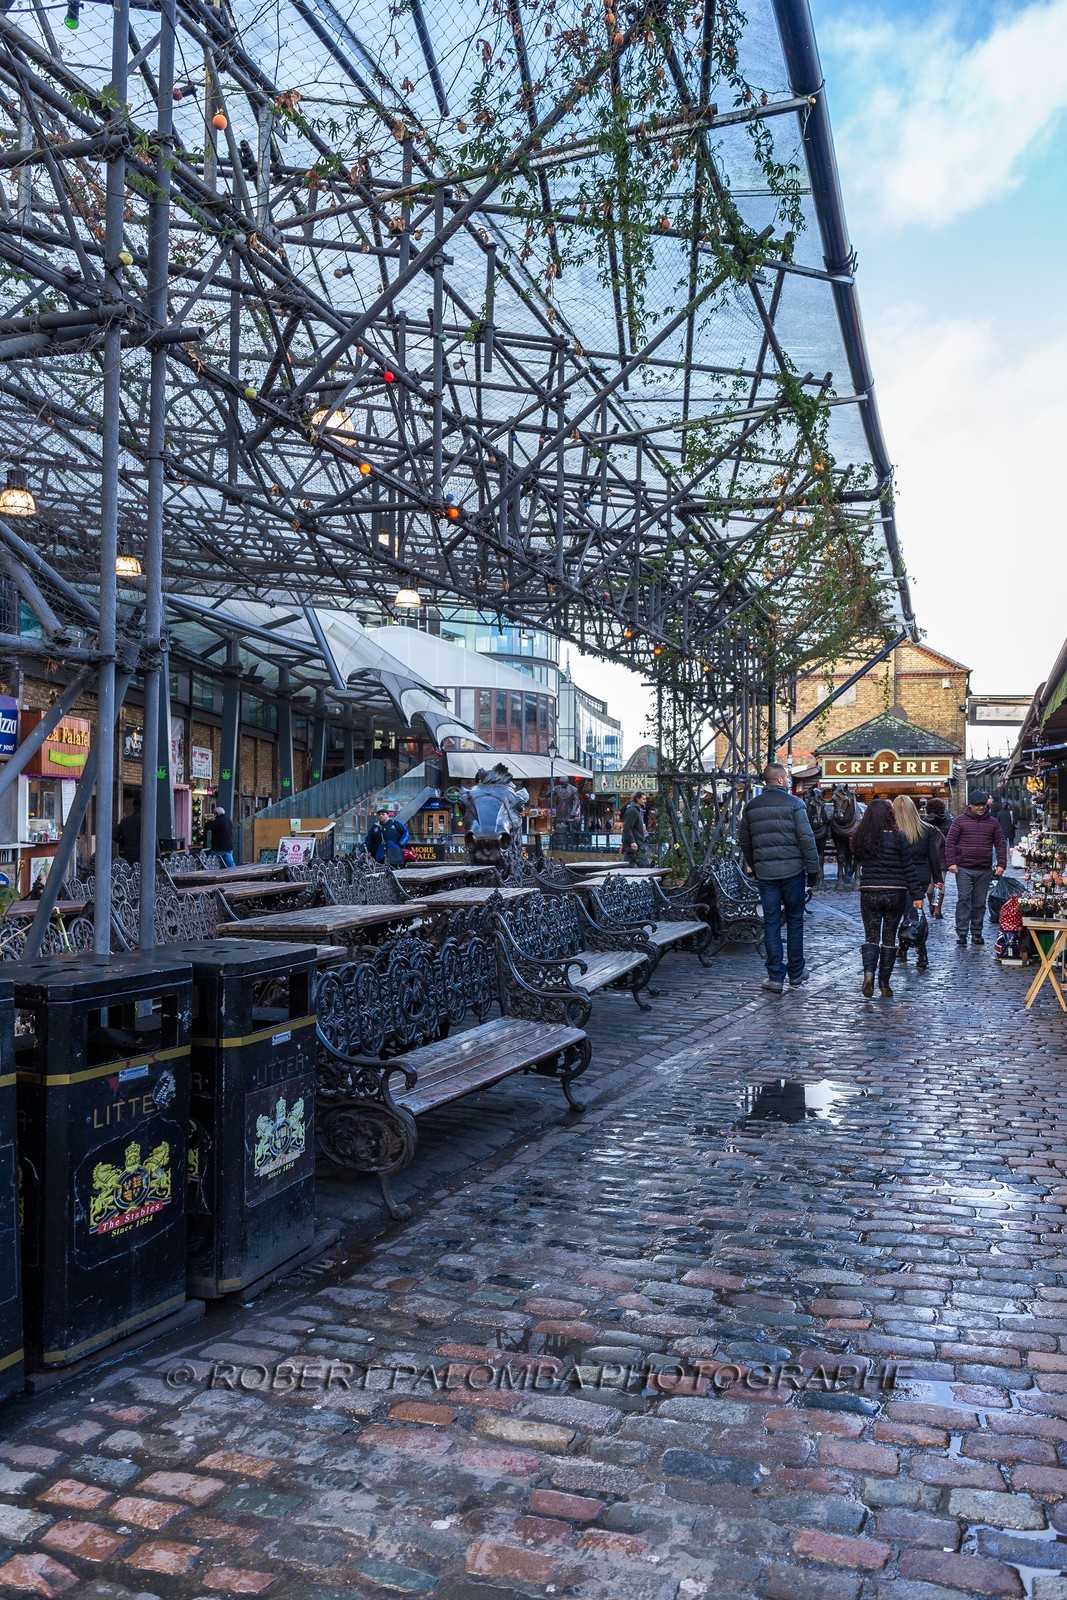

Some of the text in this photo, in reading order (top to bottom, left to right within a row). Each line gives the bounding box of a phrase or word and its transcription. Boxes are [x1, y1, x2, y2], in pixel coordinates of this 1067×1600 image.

[835, 761, 939, 774] CREPERIE
[613, 775, 658, 791] MARKET
[411, 846, 434, 854] MORE
[417, 852, 437, 860] TALLS
[93, 1094, 161, 1129] LITTE
[102, 1201, 161, 1232] The Stables
[111, 1214, 154, 1238] Since 1854
